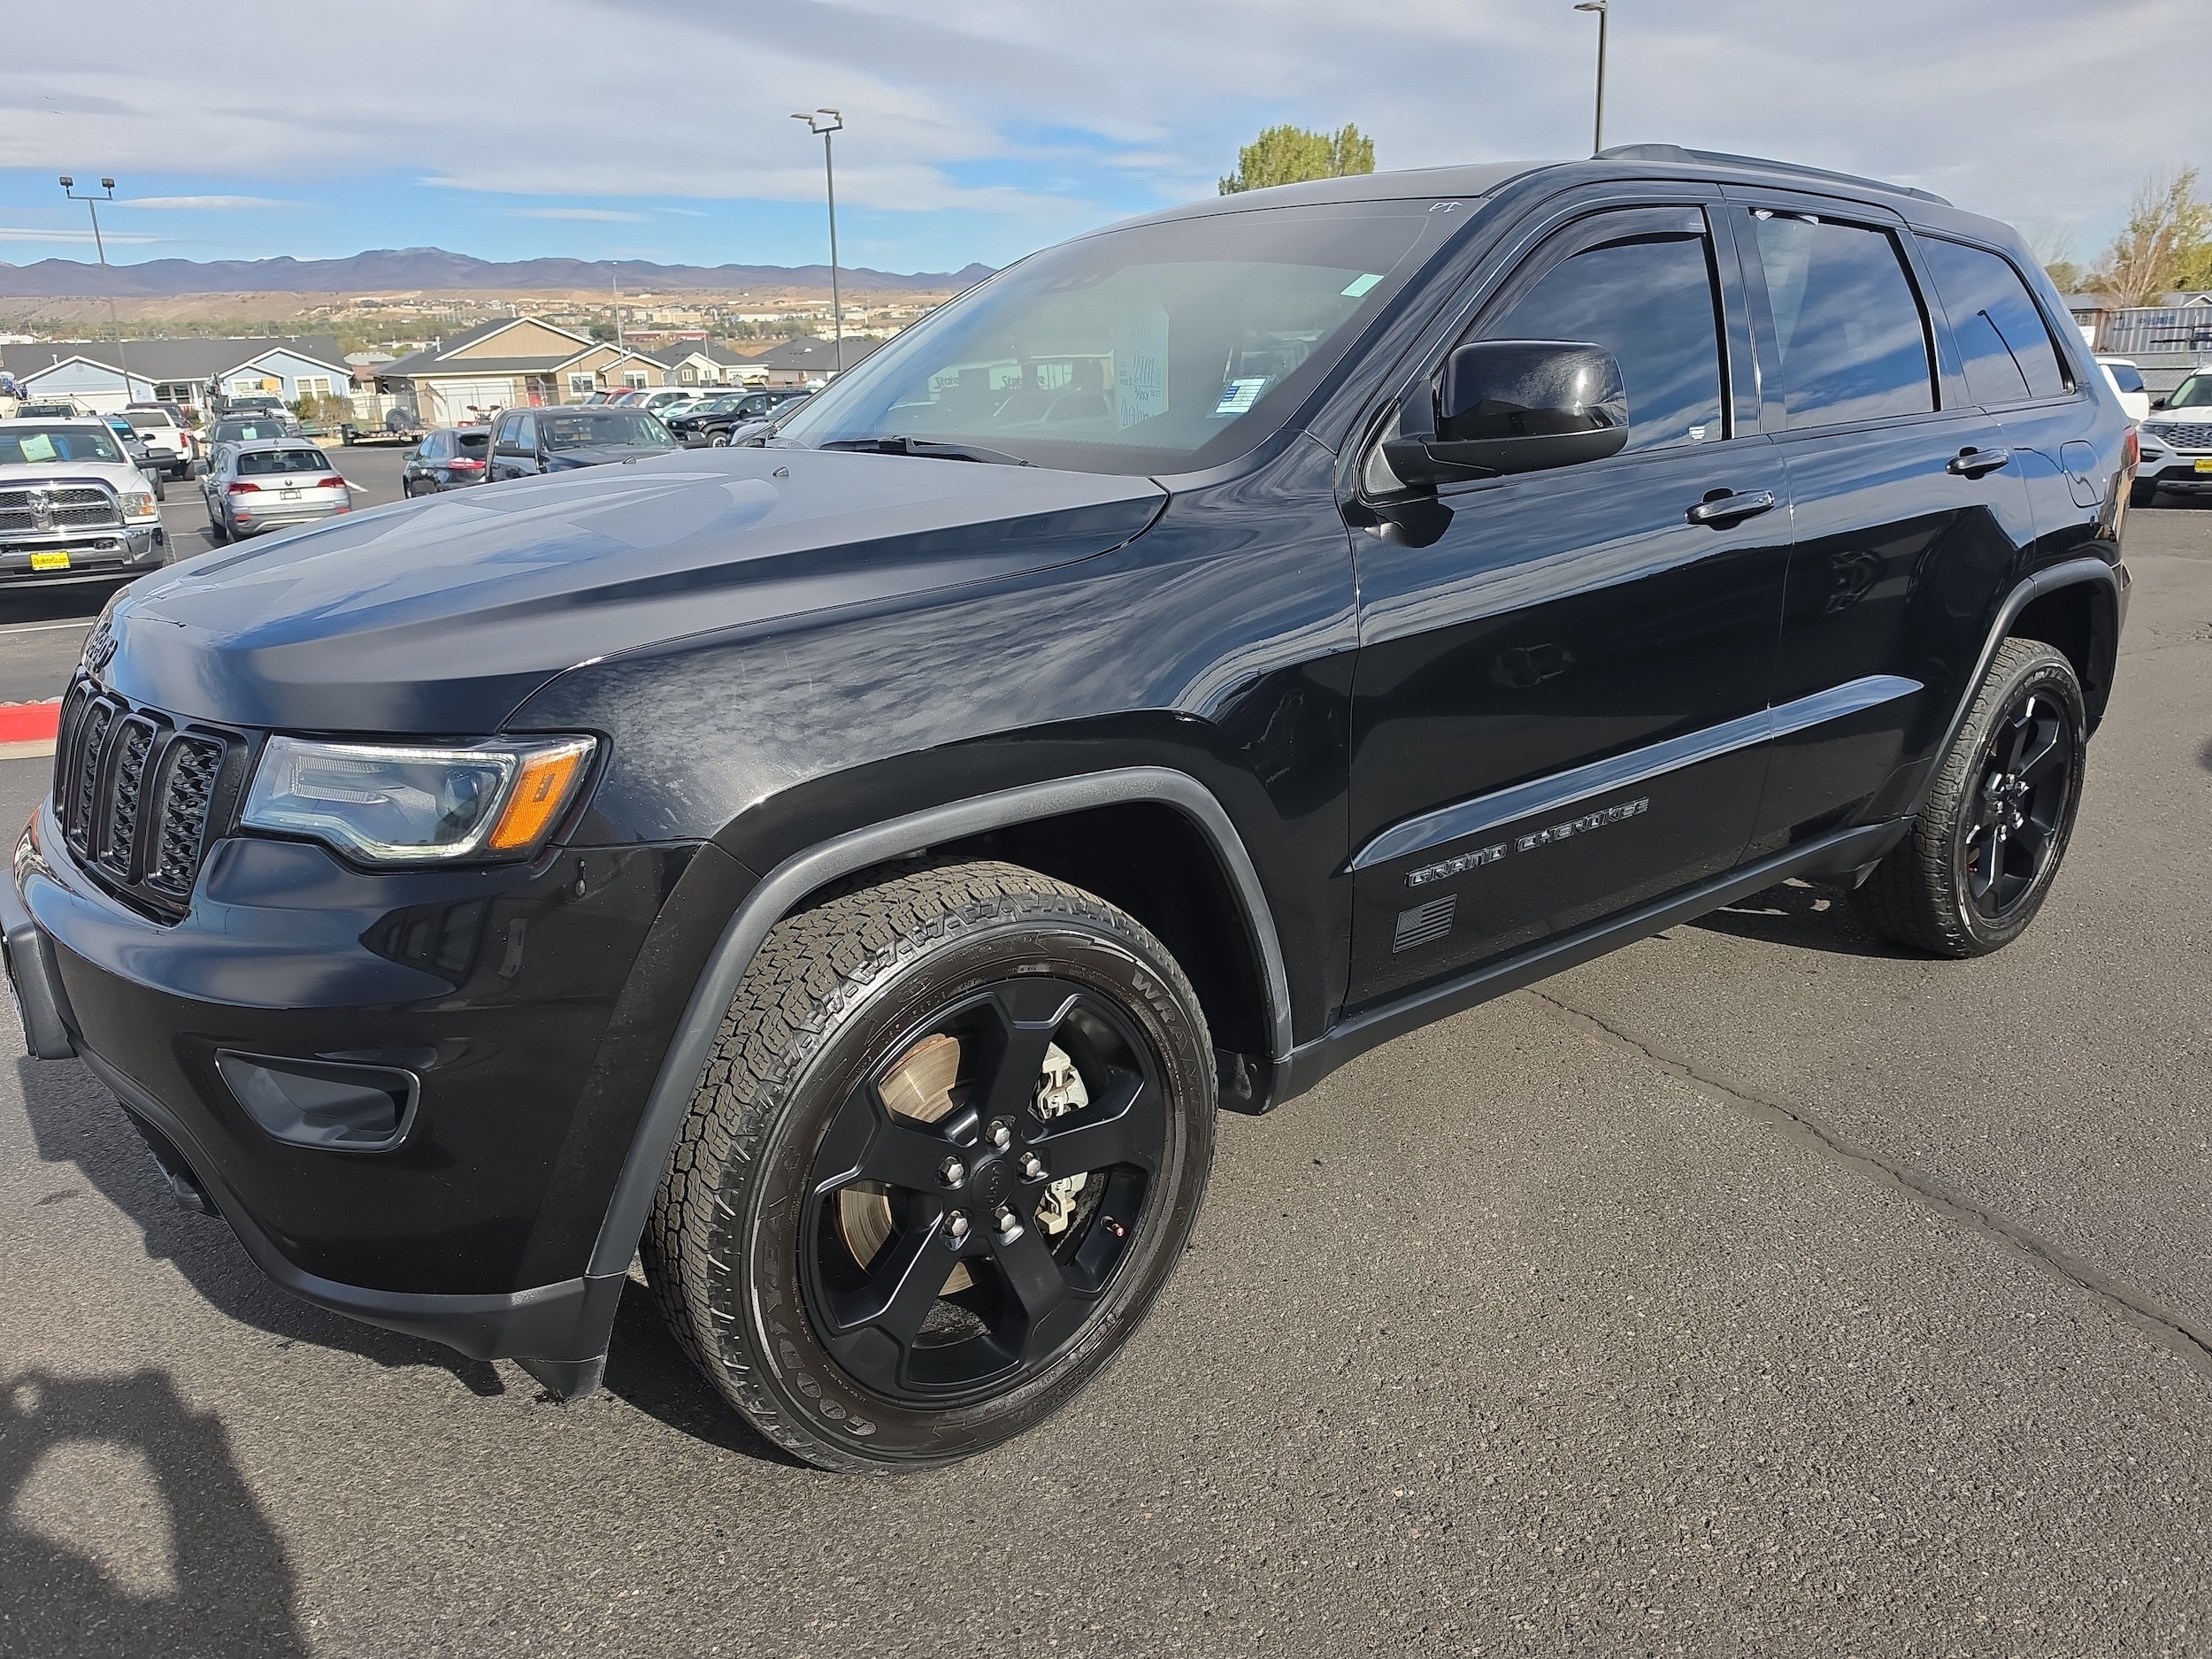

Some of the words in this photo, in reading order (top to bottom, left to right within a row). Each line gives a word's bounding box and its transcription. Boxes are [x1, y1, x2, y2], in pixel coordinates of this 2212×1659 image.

[1404, 843, 1508, 887] GRAND
[1514, 796, 1650, 852] CHEROKEE
[1130, 969, 1202, 1227] WRANGLER
[762, 1148, 878, 1437] GOODYEAR
